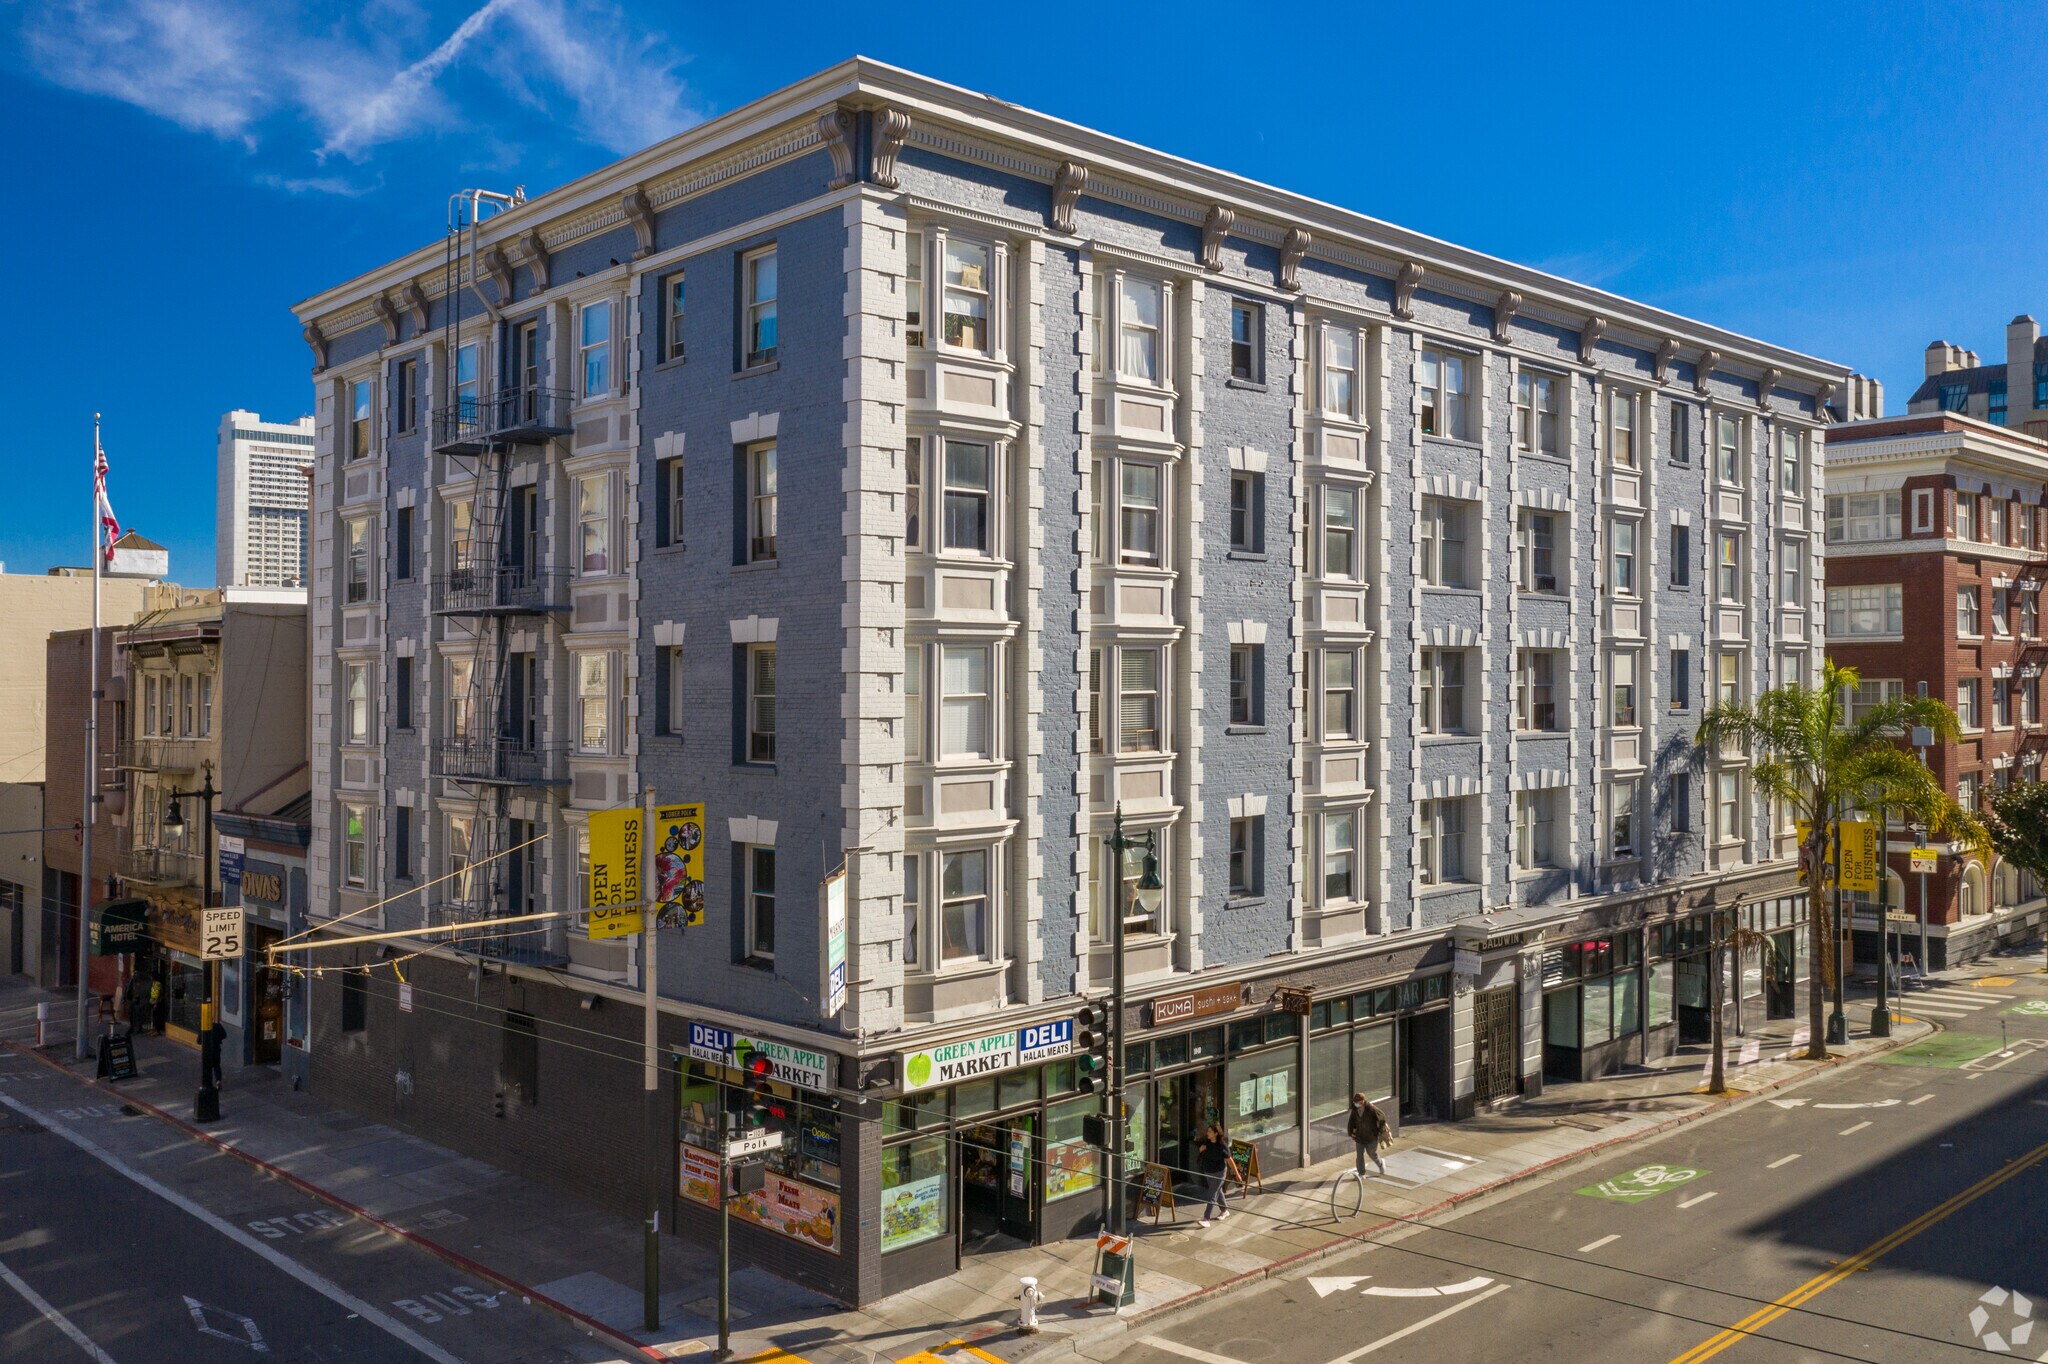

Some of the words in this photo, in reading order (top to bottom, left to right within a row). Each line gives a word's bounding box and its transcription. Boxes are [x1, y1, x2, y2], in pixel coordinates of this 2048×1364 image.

[624, 819, 638, 915] BUSINESS
[1844, 849, 1853, 880] OPEN
[1864, 828, 1873, 881] BUSINESS
[1854, 861, 1862, 880] FOR
[242, 871, 281, 902] DIVAS
[593, 863, 608, 918] OPEN
[610, 882, 621, 918] FOR
[104, 922, 144, 934] AMERICA
[205, 911, 241, 922] SPEED
[208, 923, 237, 933] LIMIT
[110, 932, 138, 942] HOTEL
[206, 935, 239, 954] 25
[1482, 933, 1519, 950] BALDWIN
[1197, 996, 1216, 1010] sushi
[1395, 975, 1443, 1008] BAREY
[1158, 1000, 1193, 1018] KUMA
[693, 1025, 728, 1050] DELI
[1025, 1021, 1068, 1048] DELI
[692, 1047, 711, 1061] HALAL
[711, 1052, 730, 1066] MEAS
[756, 1040, 790, 1061] GREEN
[793, 1049, 826, 1071] APPLE
[934, 1040, 976, 1063] GREEN
[979, 1032, 1016, 1055] APPLE
[1023, 1048, 1046, 1062] HALAL
[1047, 1044, 1069, 1057] MEATS
[773, 1064, 822, 1089] ARKET
[940, 1051, 1012, 1082] MARKET
[743, 1138, 768, 1151] Polk
[811, 1127, 831, 1141] Open
[247, 1209, 344, 1239] STOP
[392, 1285, 500, 1324] BUS
